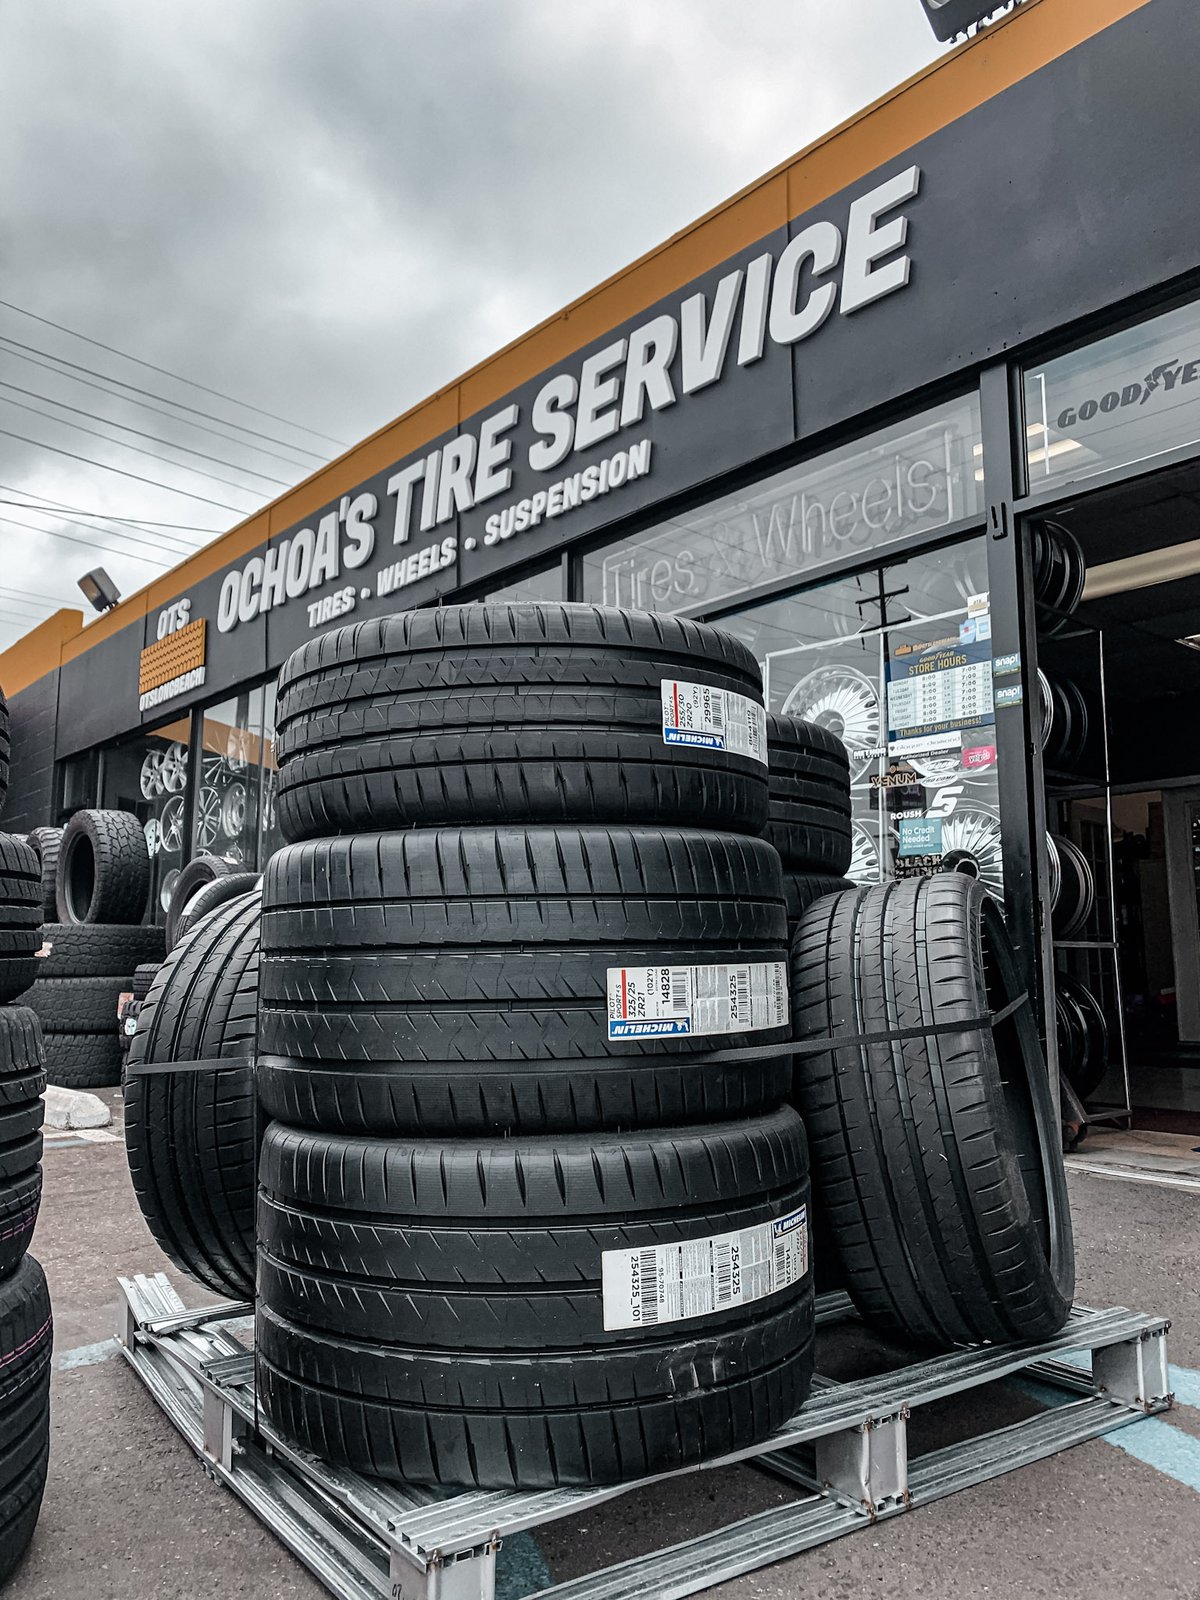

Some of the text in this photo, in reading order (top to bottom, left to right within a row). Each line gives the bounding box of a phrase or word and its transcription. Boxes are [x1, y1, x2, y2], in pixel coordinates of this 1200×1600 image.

[217, 165, 921, 633] OCHOA'S TIRE SERVICE
[307, 439, 652, 628] TIRES WHEELS SUSPENSION
[608, 550, 699, 609] Tires
[753, 455, 937, 568] Wheels
[157, 598, 191, 640] OTS
[908, 655, 967, 676] STORE HOURS
[962, 665, 977, 673] 7:00
[995, 654, 1018, 667] snap!
[962, 680, 977, 688] 7:00
[997, 686, 1020, 698] snap!
[703, 688, 712, 723] 29965
[900, 715, 982, 737] Thanks for your business!
[667, 732, 713, 745] MICHELIN
[900, 752, 930, 760] Authorized
[890, 810, 922, 820] ROUSH
[902, 834, 930, 843] Needed
[661, 968, 670, 1005] 14828
[730, 975, 738, 1019] 254325
[628, 982, 637, 1017] 325/25
[637, 992, 646, 1017] ZR21
[612, 1022, 673, 1035] MICHELIN
[731, 1246, 740, 1295] 254325
[630, 1256, 641, 1322] 254325_101
